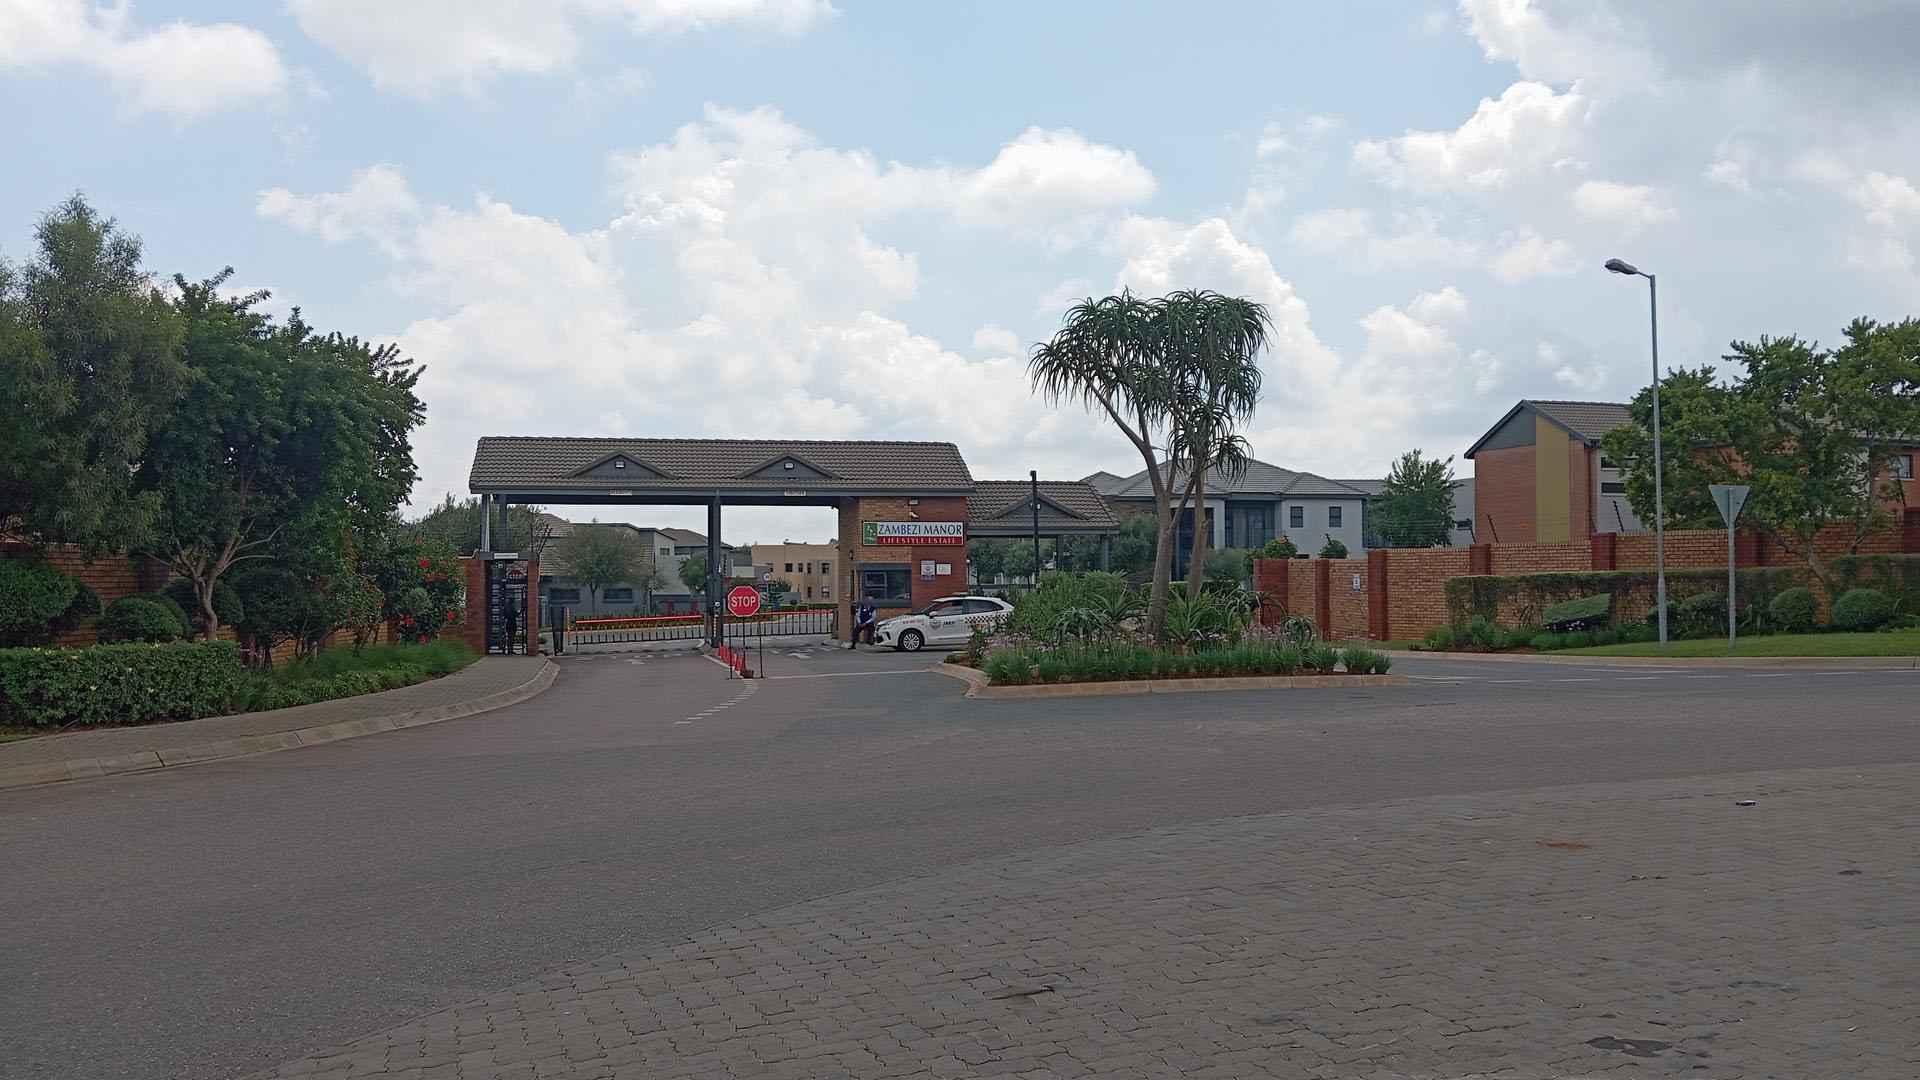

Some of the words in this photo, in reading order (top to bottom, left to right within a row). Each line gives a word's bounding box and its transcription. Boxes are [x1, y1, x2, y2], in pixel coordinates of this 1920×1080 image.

[878, 524, 921, 535] ZAMBEZI
[923, 524, 962, 535] MANOR
[731, 596, 756, 607] STOP
